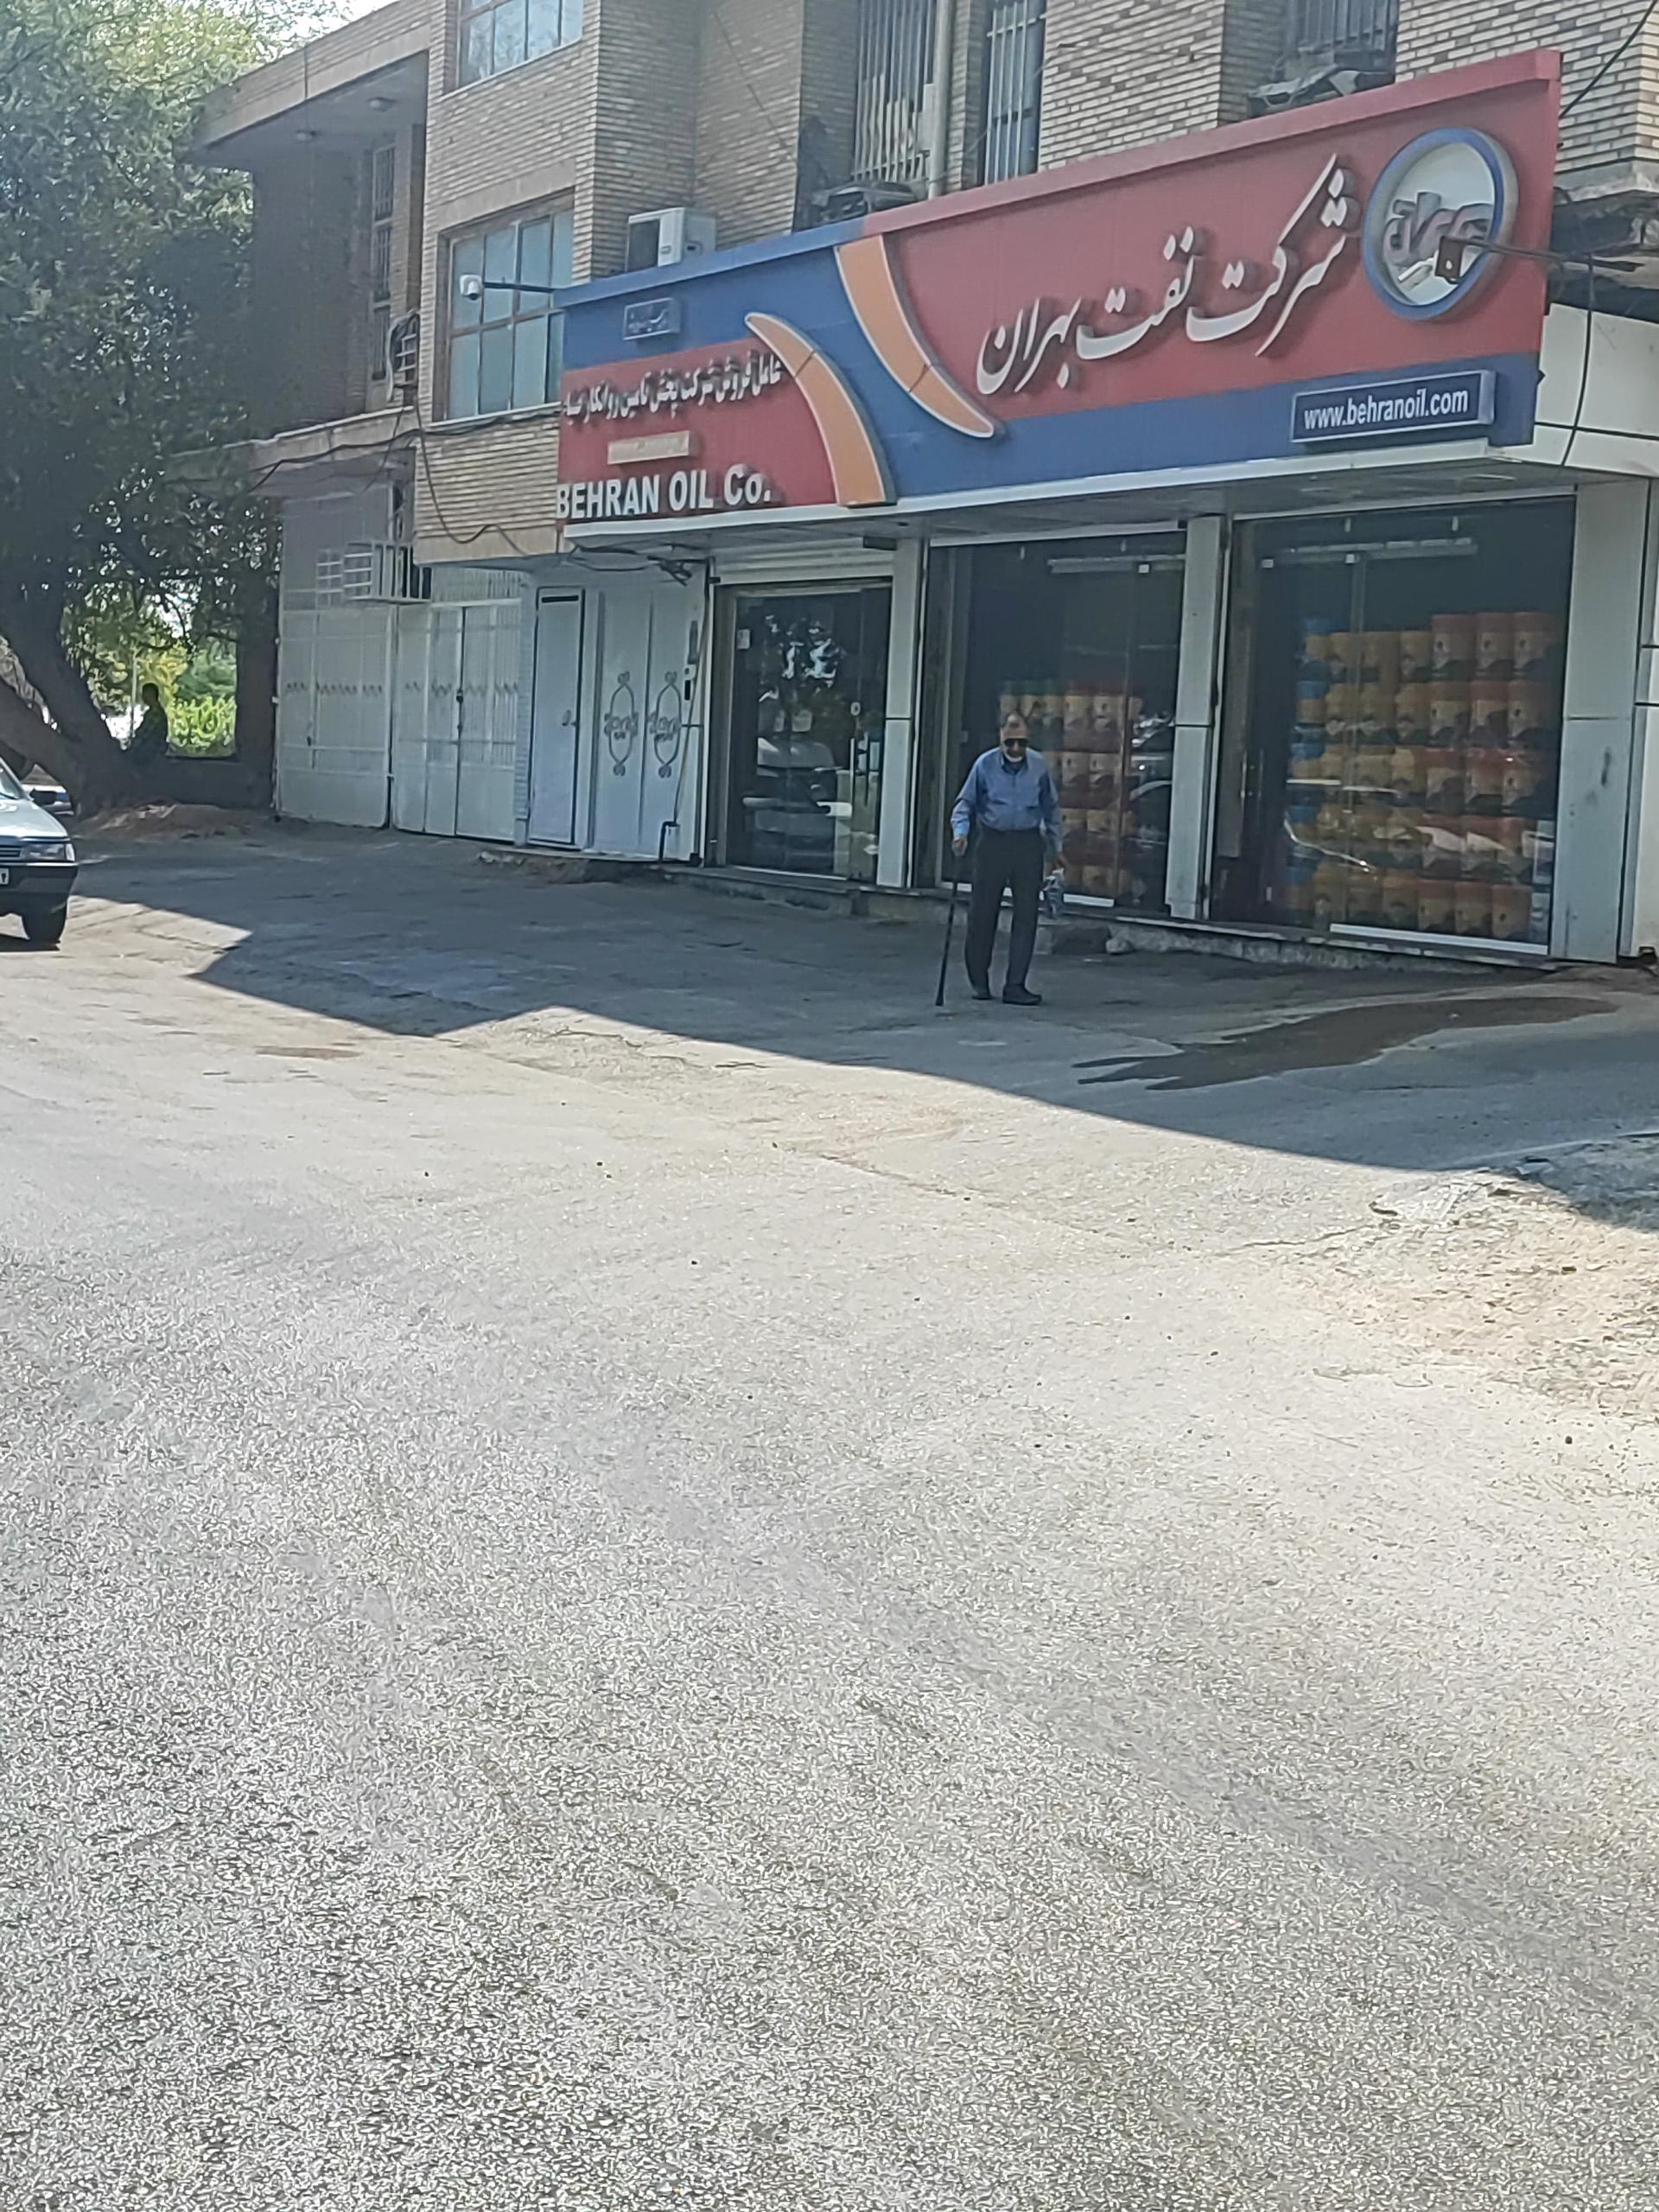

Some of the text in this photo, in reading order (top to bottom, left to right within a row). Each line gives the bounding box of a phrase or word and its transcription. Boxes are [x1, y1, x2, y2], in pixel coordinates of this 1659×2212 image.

[976, 154, 1347, 396] شرکت نفت بهران
[650, 368, 679, 419] پخش
[680, 359, 715, 406] شرکت
[715, 350, 751, 404] فروش
[751, 352, 782, 397] عامل
[1303, 386, 1468, 430] www.behranoil.com
[556, 464, 772, 519] BEHRAN OIL Co.
